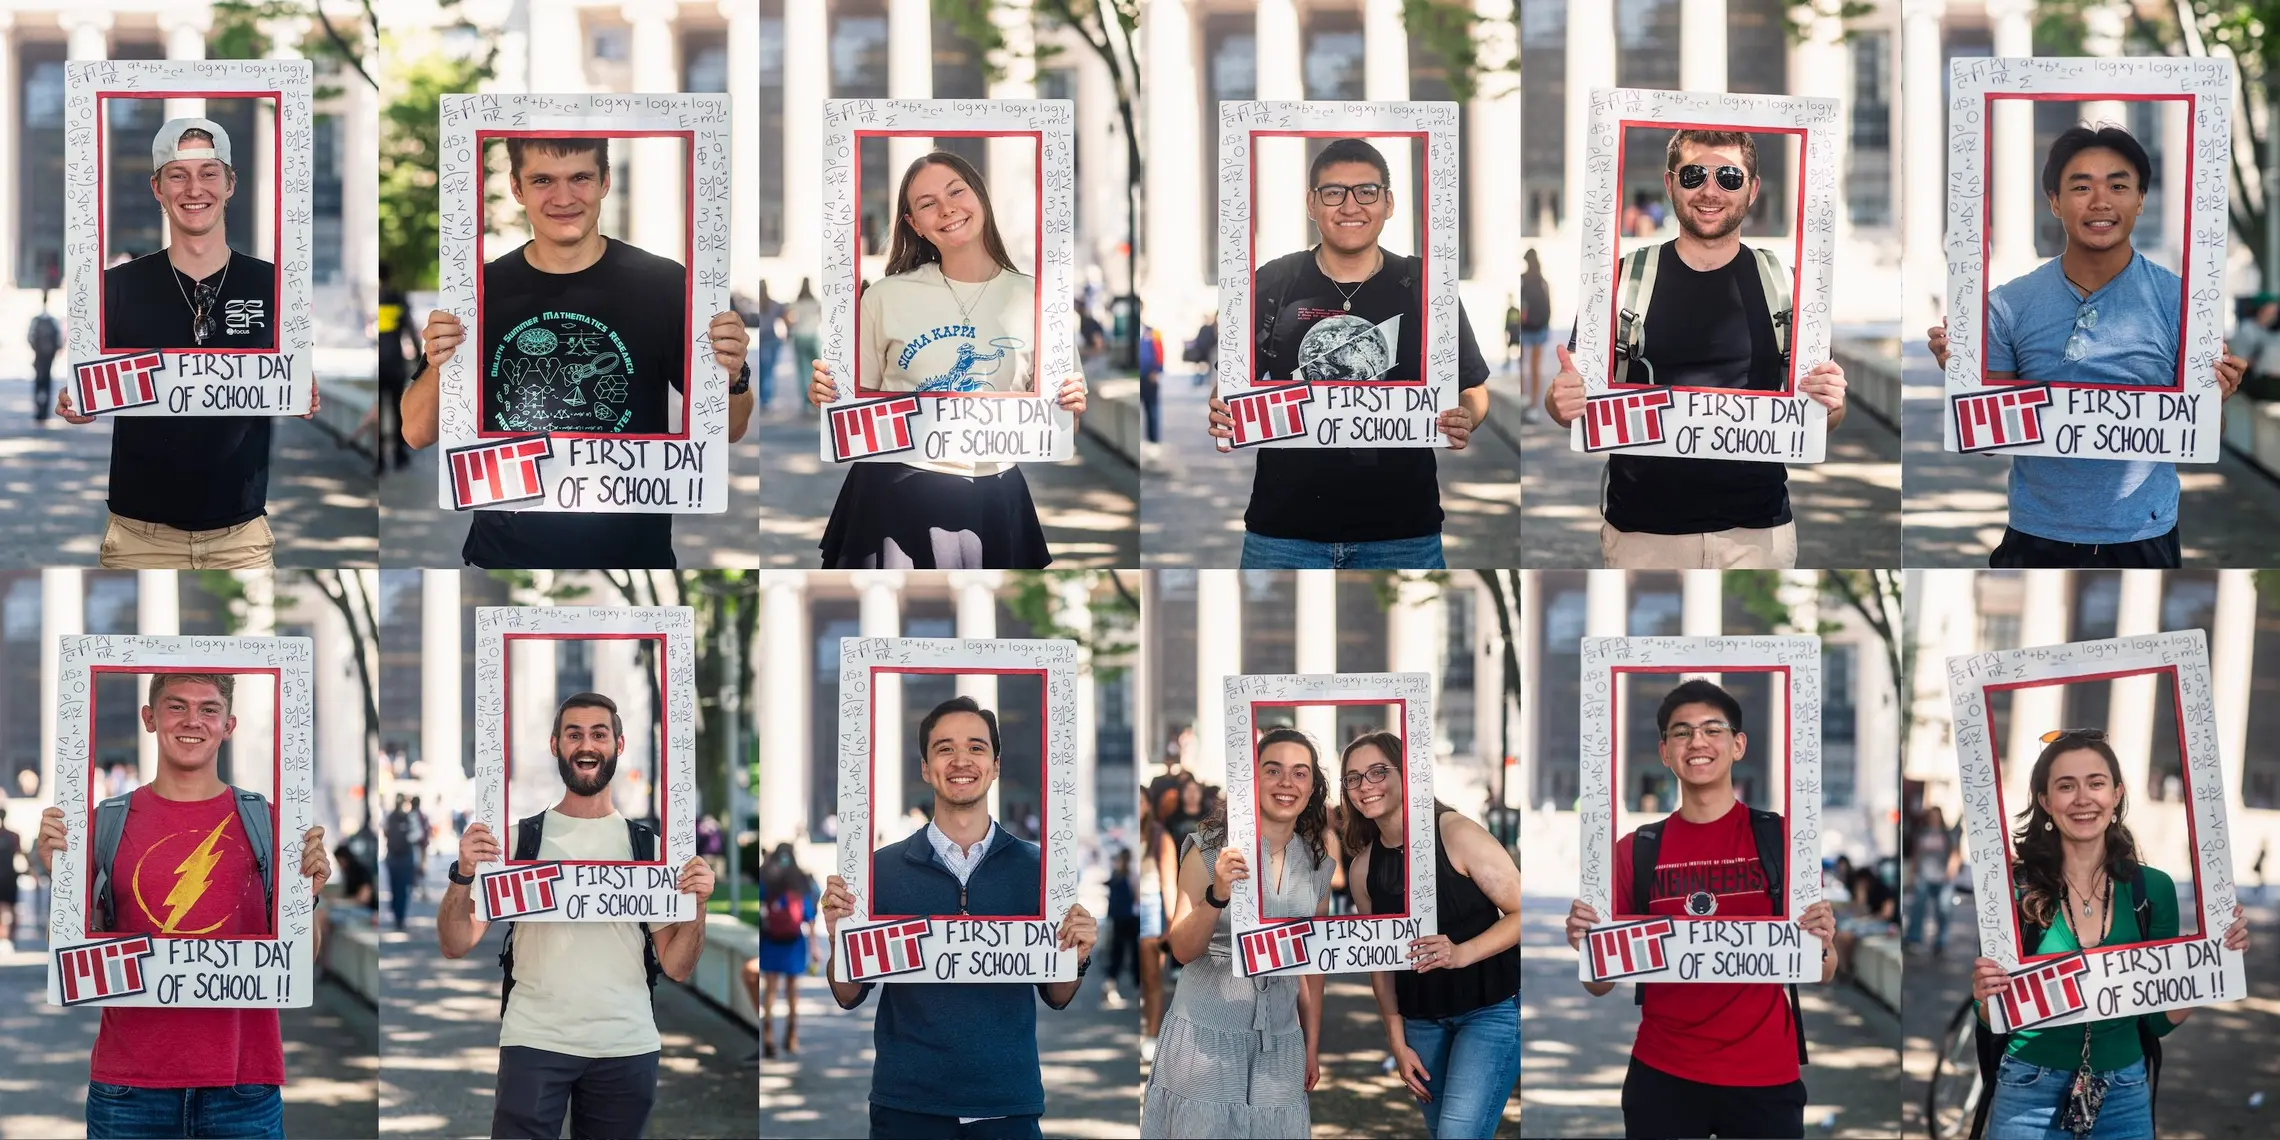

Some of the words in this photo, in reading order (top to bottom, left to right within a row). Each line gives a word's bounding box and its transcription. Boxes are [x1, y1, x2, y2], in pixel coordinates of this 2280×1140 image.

[491, 345, 505, 377] DULUTH
[543, 311, 609, 333] MATHEMATICS
[608, 331, 635, 375] RESEARCH
[898, 334, 932, 370] SIGMA
[931, 325, 976, 339] KAPPA
[178, 352, 247, 381] FIRST
[257, 353, 295, 382] DAY
[168, 385, 195, 414] OF
[201, 384, 271, 411] SCHOOL
[936, 396, 1006, 426] FIRST
[1017, 397, 1055, 427] DAY
[1327, 384, 1395, 413] FIRST
[1405, 386, 1441, 414] DAY
[1688, 391, 1760, 423] FIRST
[1770, 398, 1809, 428] DAY
[2068, 387, 2146, 421] FIRST
[2158, 393, 2201, 425] DAY
[925, 430, 953, 460] OF
[959, 428, 1031, 456] SCHOOL
[1317, 417, 1344, 446] OF
[1350, 416, 1418, 442] SCHOOL
[1675, 425, 1705, 455] OF
[1710, 425, 1782, 455] SCHOOL
[2055, 423, 2086, 455] OF
[2093, 423, 2171, 454] SCHOOL
[569, 437, 651, 471] FIRST
[663, 440, 707, 474] DAY
[557, 476, 589, 509] OF
[596, 475, 678, 506] SCHOOL
[575, 864, 637, 890] FIRST
[646, 866, 680, 891] DAY
[566, 893, 591, 920] OF
[596, 892, 659, 917] SCHOOL
[946, 919, 1014, 948] FIRST
[1024, 921, 1060, 949] DAY
[1326, 918, 1383, 943] FIRST
[1391, 916, 1422, 941] DAY
[1689, 919, 1757, 948] FIRST
[1767, 921, 1804, 949] DAY
[169, 937, 243, 969] FIRST
[254, 940, 294, 971] DAY
[935, 952, 962, 981] OF
[968, 950, 1037, 977] SCHOOL
[1318, 947, 1341, 972] OF
[1346, 945, 1404, 968] SCHOOL
[1678, 952, 1706, 980] OF
[1711, 950, 1780, 977] SCHOOL
[2102, 944, 2173, 978] FIRST
[2184, 937, 2222, 970] DAY
[157, 973, 187, 1005] OF
[193, 972, 268, 1002] SCHOOL
[2097, 984, 2124, 1017] OF
[2132, 975, 2204, 1007] SCHOOL
